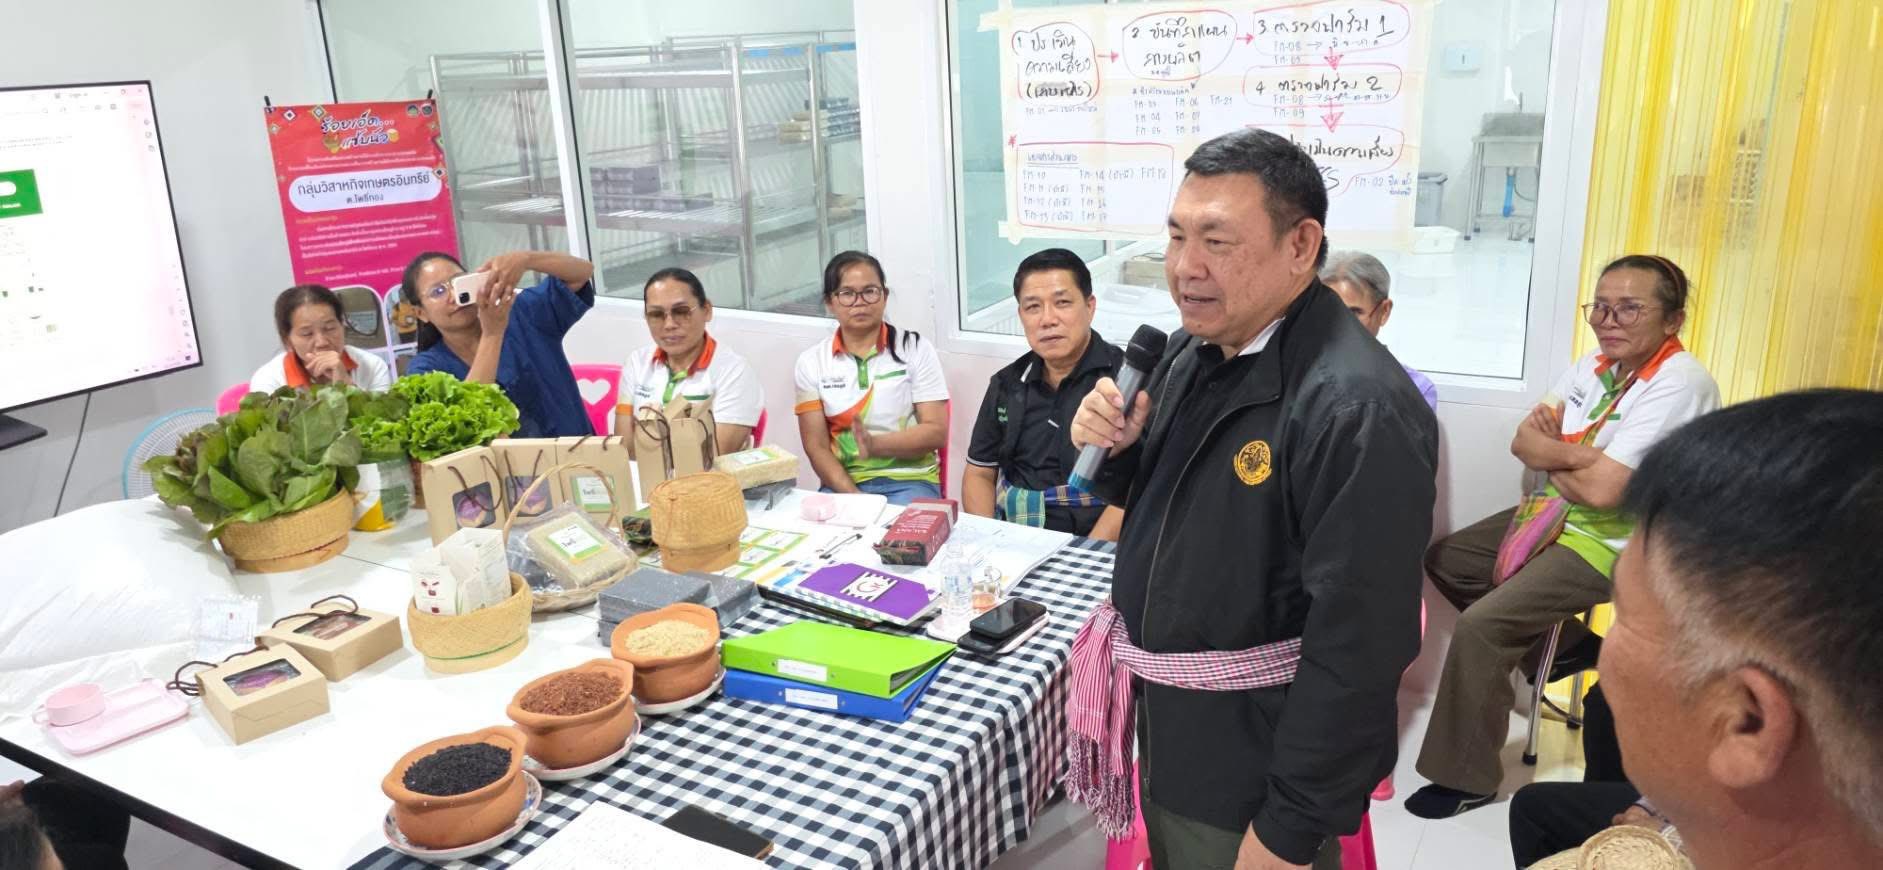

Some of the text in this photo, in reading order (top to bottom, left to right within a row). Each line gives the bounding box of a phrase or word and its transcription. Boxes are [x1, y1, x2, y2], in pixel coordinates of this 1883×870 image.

[1258, 19, 1267, 35] 3
[1255, 81, 1264, 94] 4
[1365, 76, 1381, 91] 2
[297, 171, 430, 199] กลุ่มวิสาหกิจเกษตรอินทรีย์
